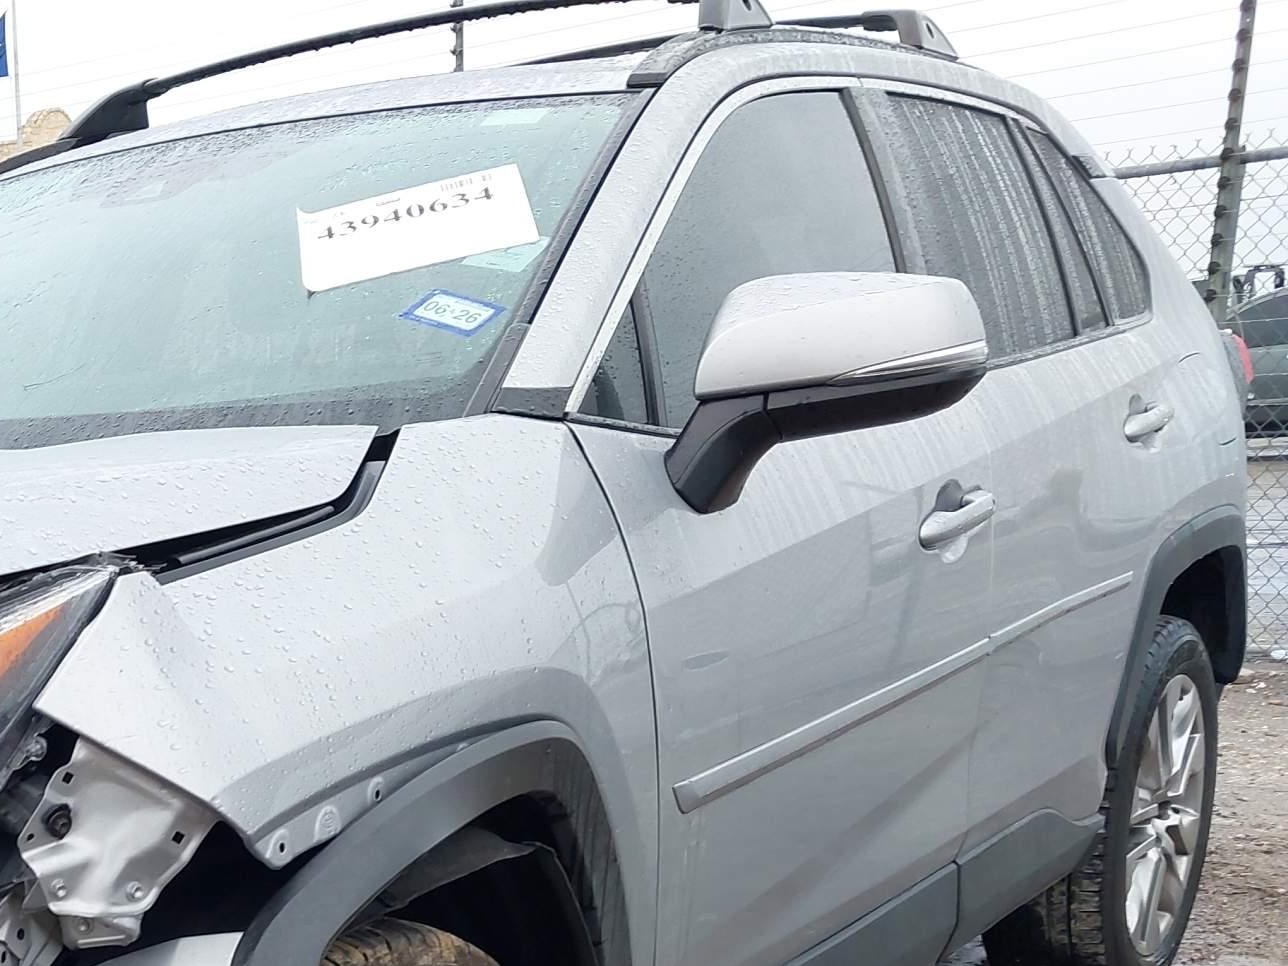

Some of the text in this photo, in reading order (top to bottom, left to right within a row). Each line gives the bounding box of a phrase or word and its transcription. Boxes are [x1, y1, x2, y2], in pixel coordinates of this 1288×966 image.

[317, 186, 493, 240] 43940634
[423, 301, 482, 324] 06 26
